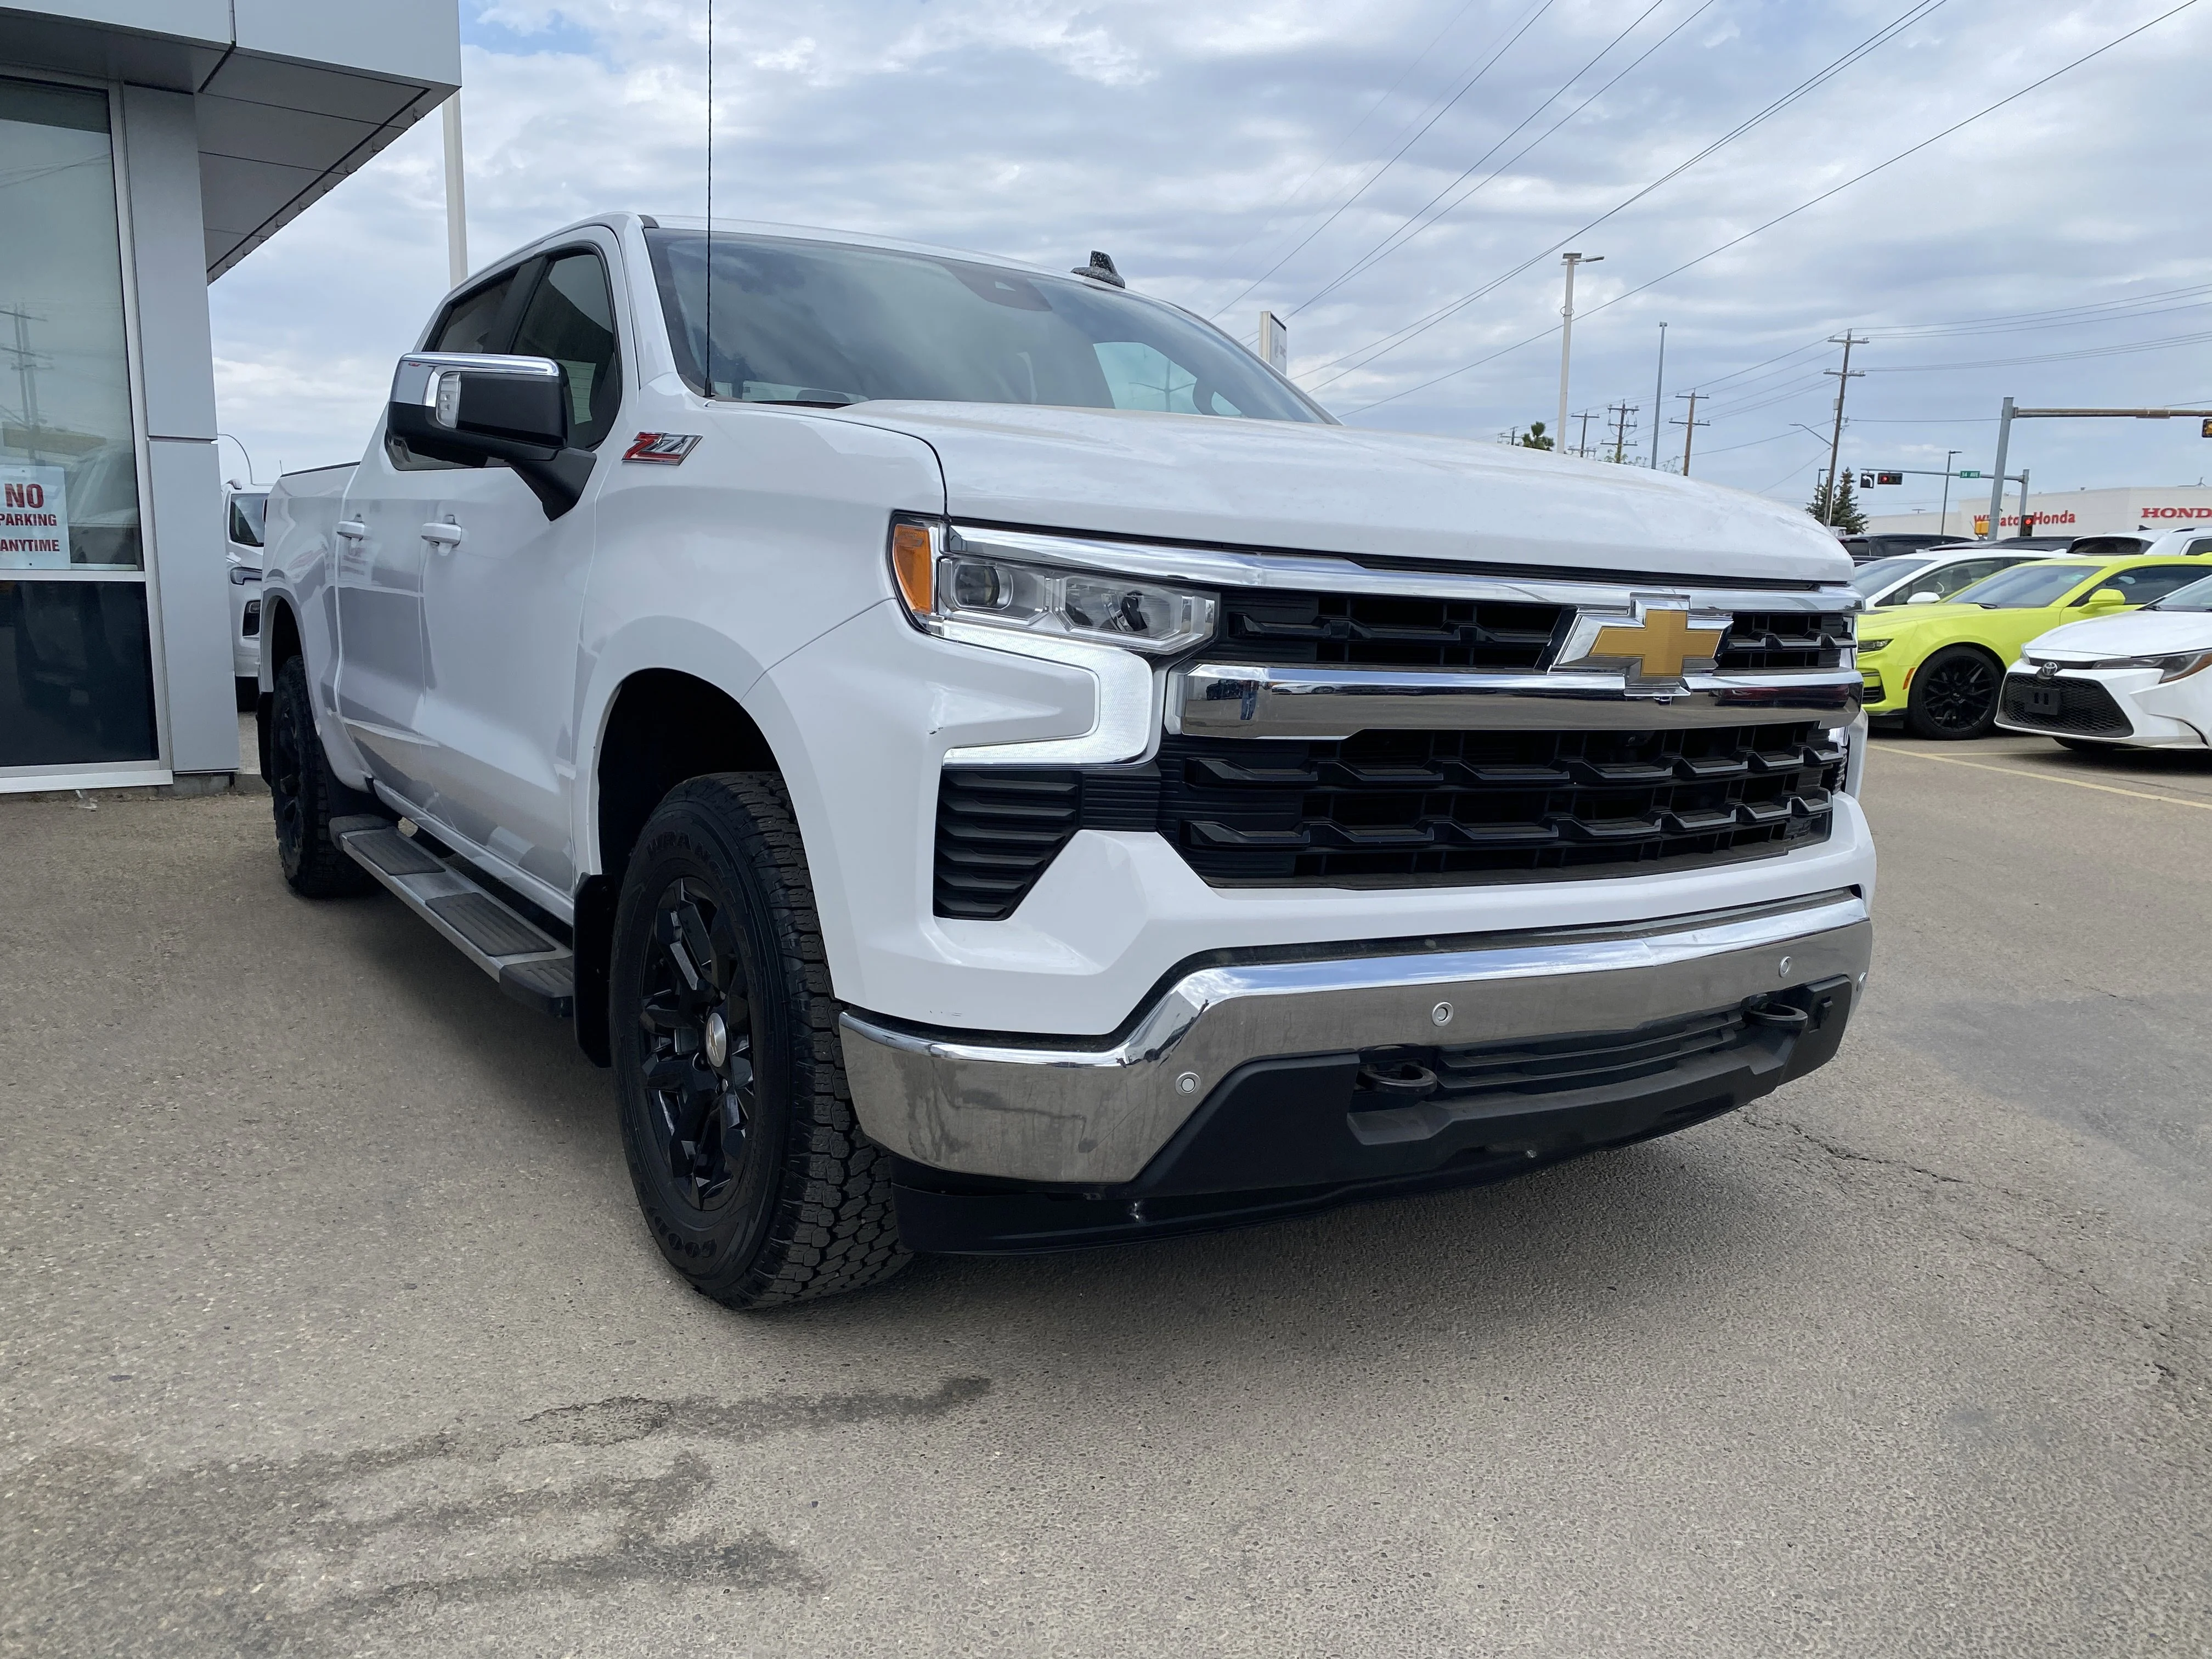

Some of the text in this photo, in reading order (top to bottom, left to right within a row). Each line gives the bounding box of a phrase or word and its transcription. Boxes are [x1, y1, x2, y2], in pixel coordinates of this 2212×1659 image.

[622, 432, 703, 465] Z71
[4, 483, 44, 508] NO
[2033, 510, 2075, 525] Honda
[2141, 508, 2212, 518] HOND
[0, 514, 57, 526] PARKING
[0, 540, 60, 551] ANYTIME
